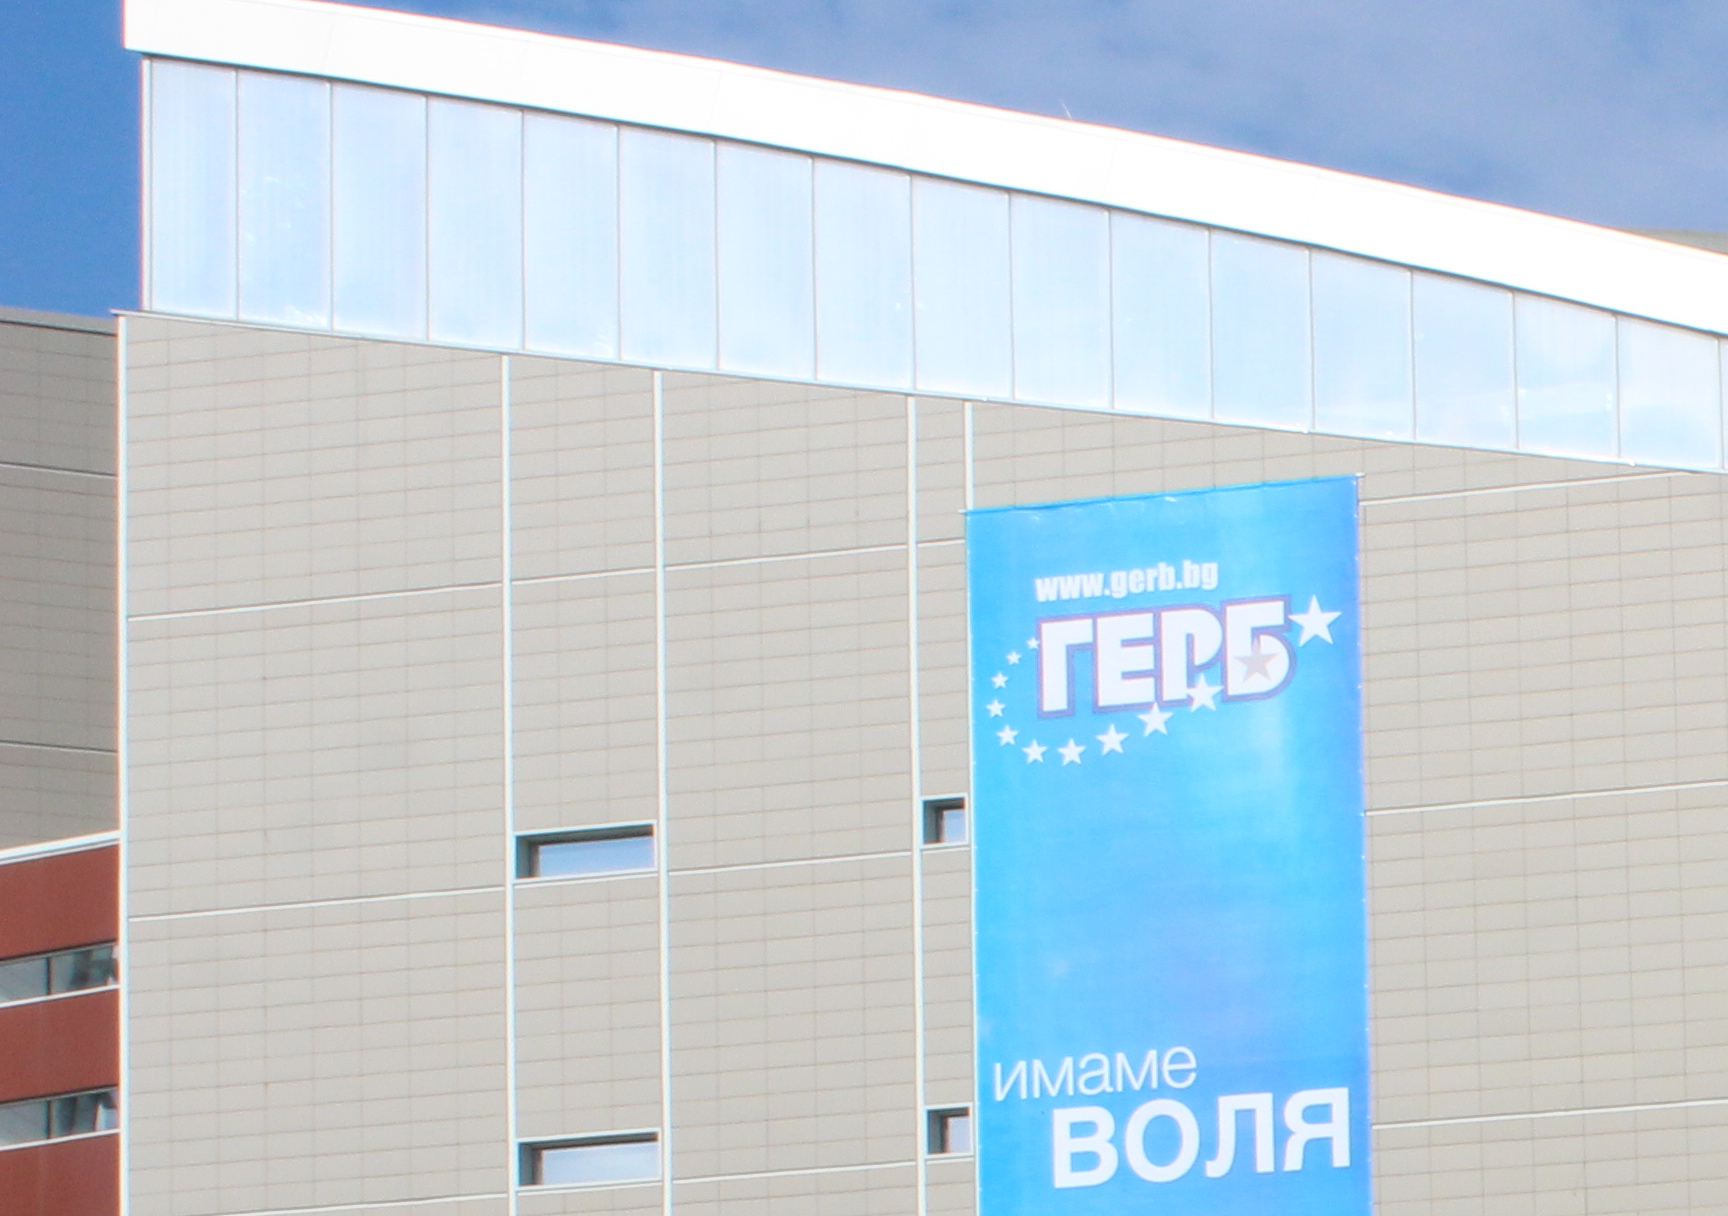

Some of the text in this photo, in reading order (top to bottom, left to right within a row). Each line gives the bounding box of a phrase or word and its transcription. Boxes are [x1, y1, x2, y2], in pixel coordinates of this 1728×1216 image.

[1034, 559, 1218, 602] www.gerb.bg
[1038, 596, 1295, 716] ГЕРБ
[993, 1046, 1198, 1102] имаме
[1052, 1086, 1351, 1190] ВОЛЯ
